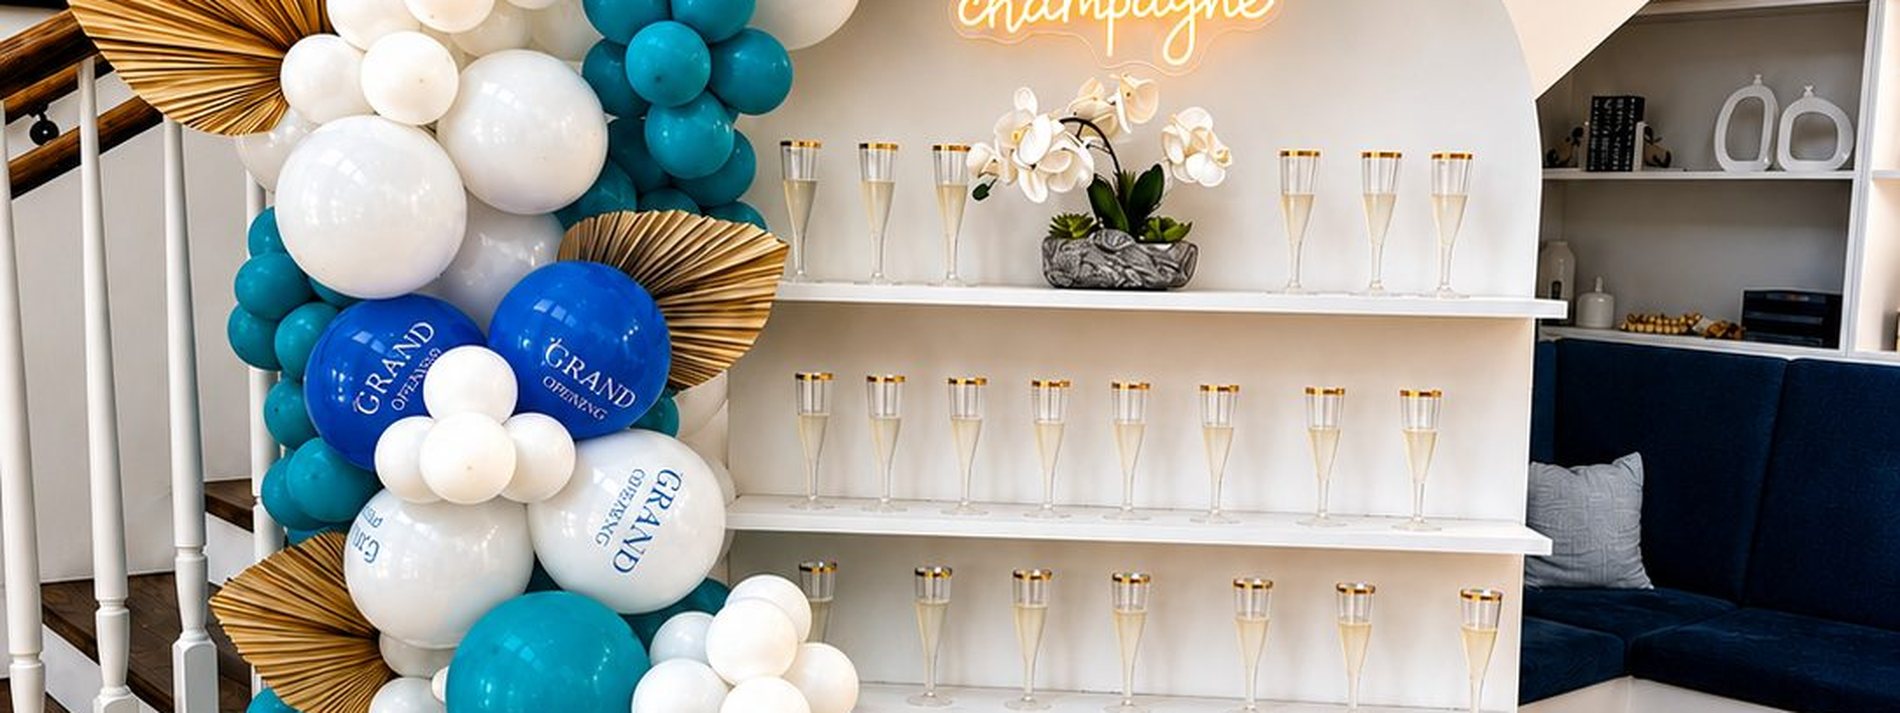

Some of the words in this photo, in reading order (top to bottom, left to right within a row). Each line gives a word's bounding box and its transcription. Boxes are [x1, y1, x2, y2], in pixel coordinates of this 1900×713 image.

[353, 322, 435, 415] GRAND
[544, 337, 637, 409] GRAND
[612, 468, 684, 574] GRAND
